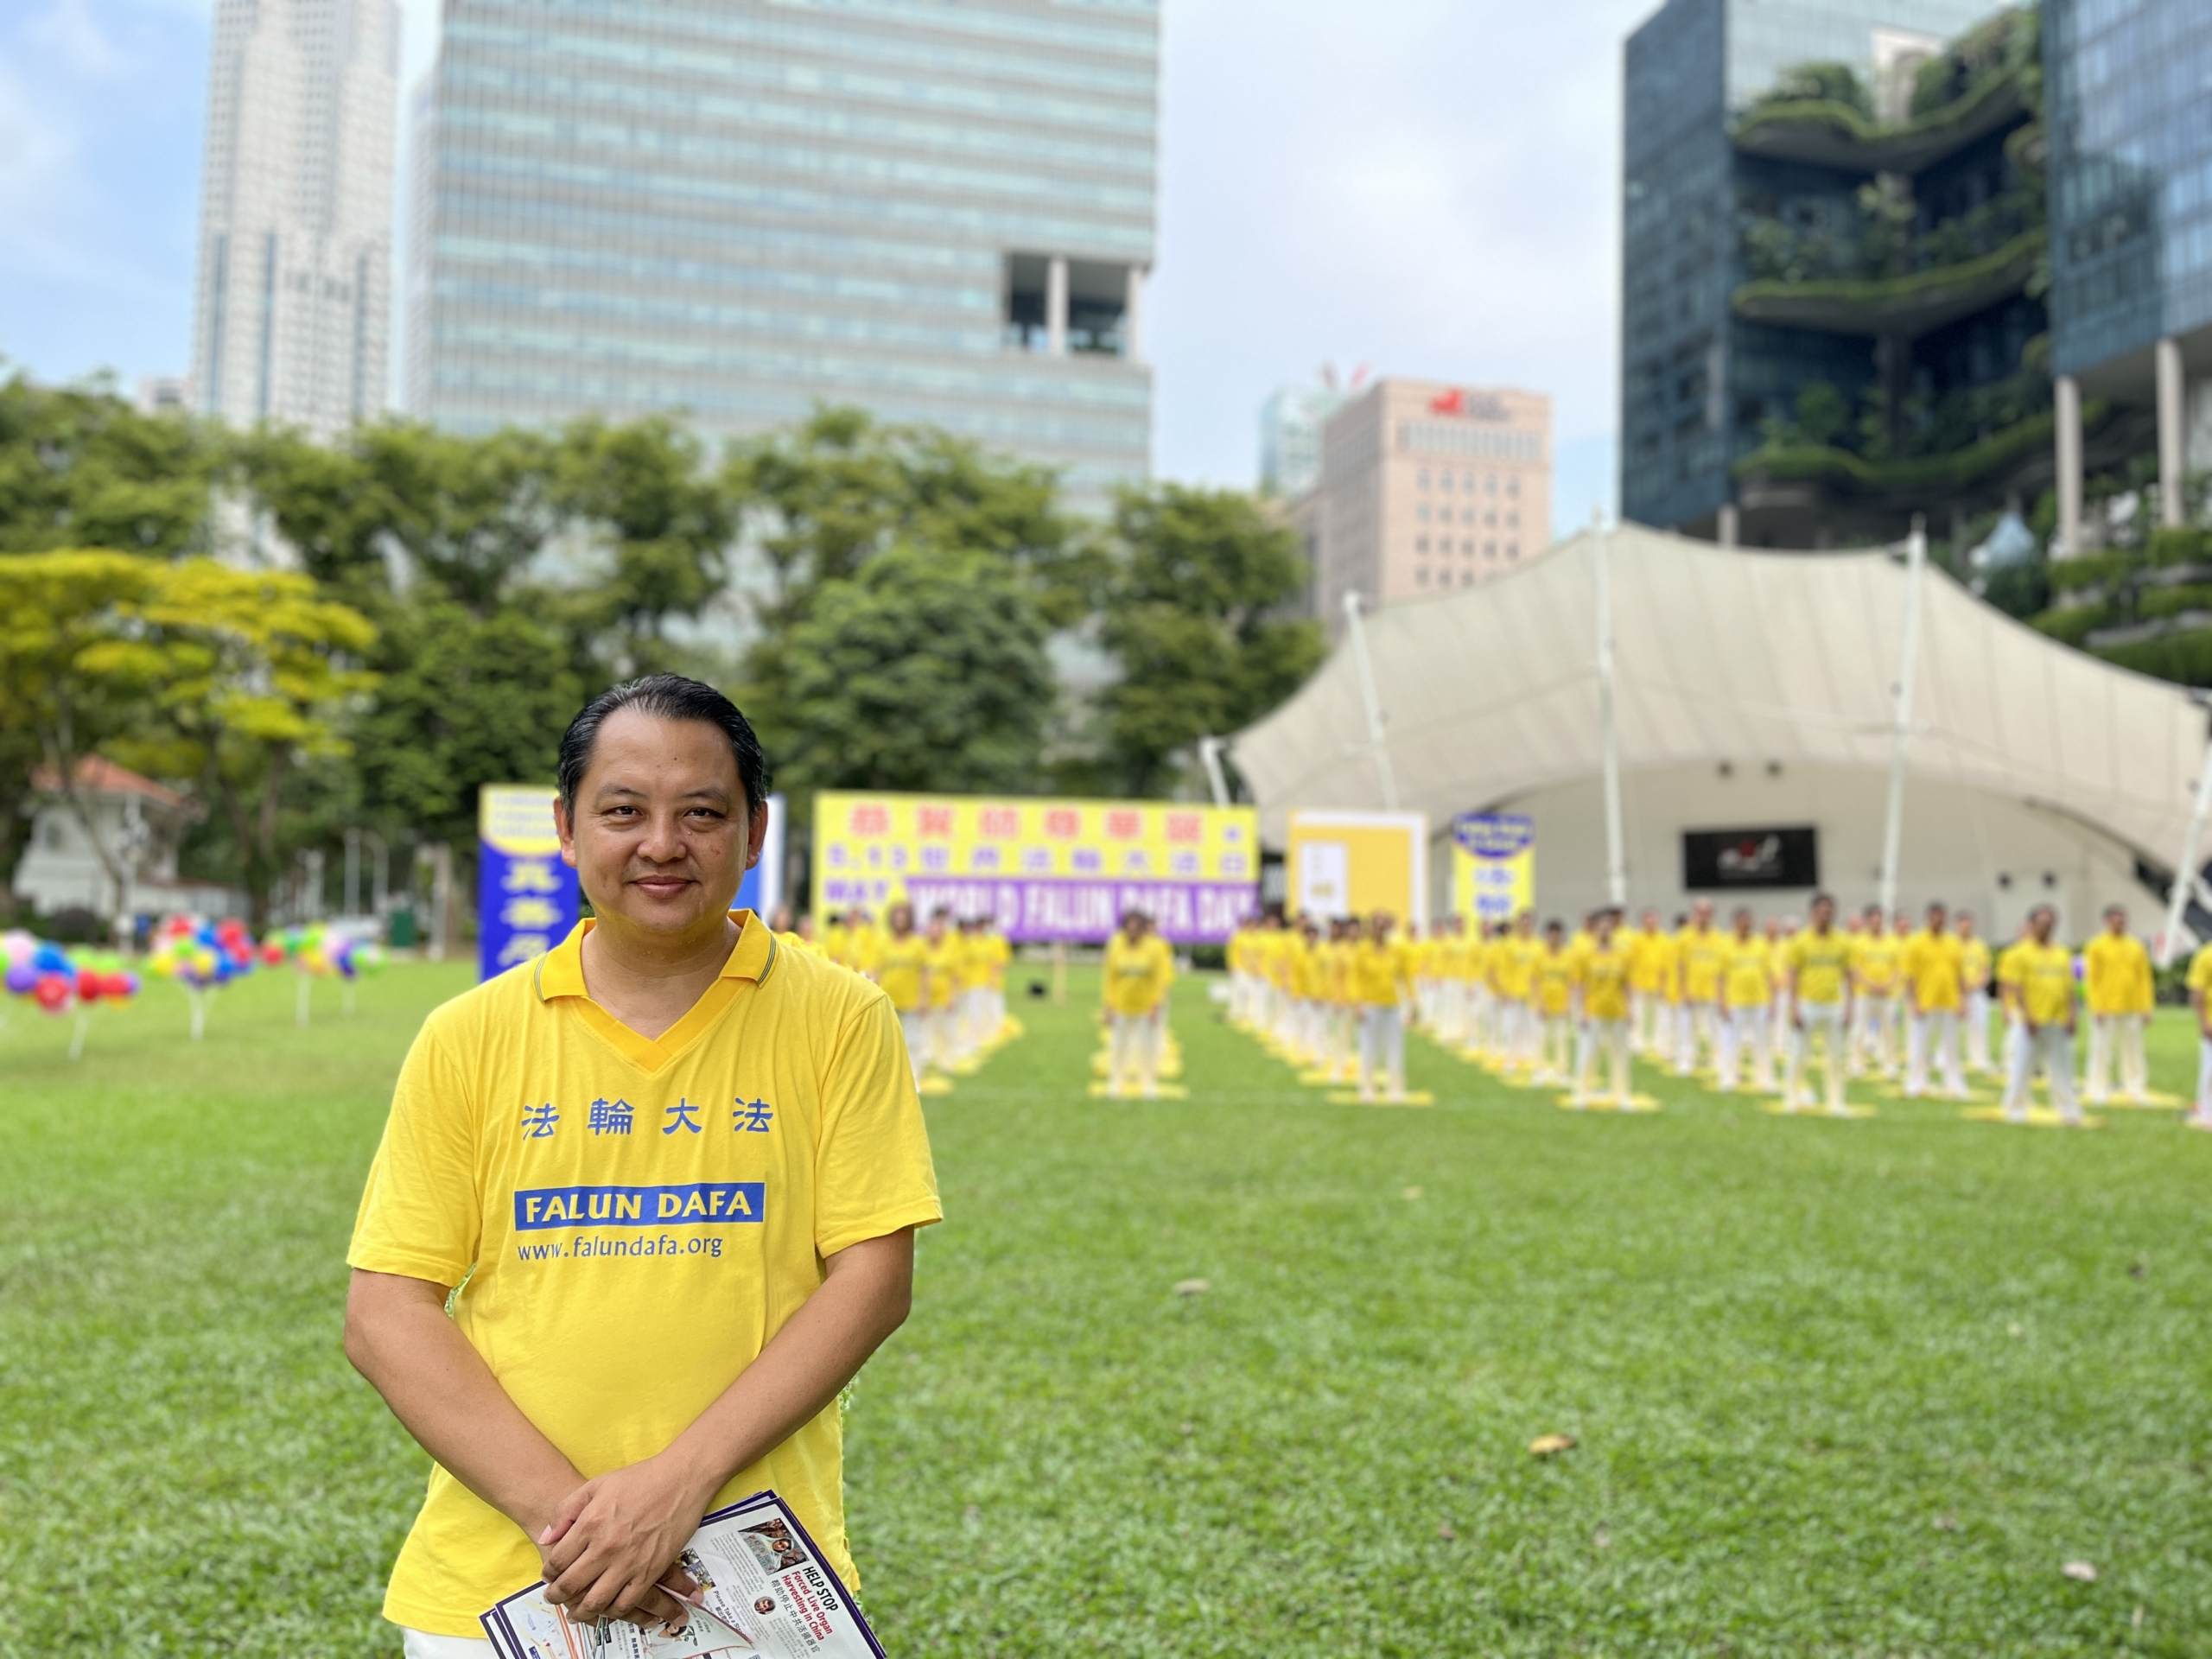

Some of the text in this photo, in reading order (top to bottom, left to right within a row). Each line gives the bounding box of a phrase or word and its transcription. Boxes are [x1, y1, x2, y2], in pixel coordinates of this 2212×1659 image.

[521, 1097, 774, 1141] 法輪大法
[525, 1191, 753, 1223] FALUN DAFA
[517, 1234, 723, 1261] www.falundafa.org
[714, 1590, 725, 1607] Please
[724, 1607, 733, 1619] Take
[781, 1574, 824, 1641] Harvesting in China
[791, 1571, 833, 1634] Forced Live Organ
[803, 1567, 838, 1611] HELP STOP
